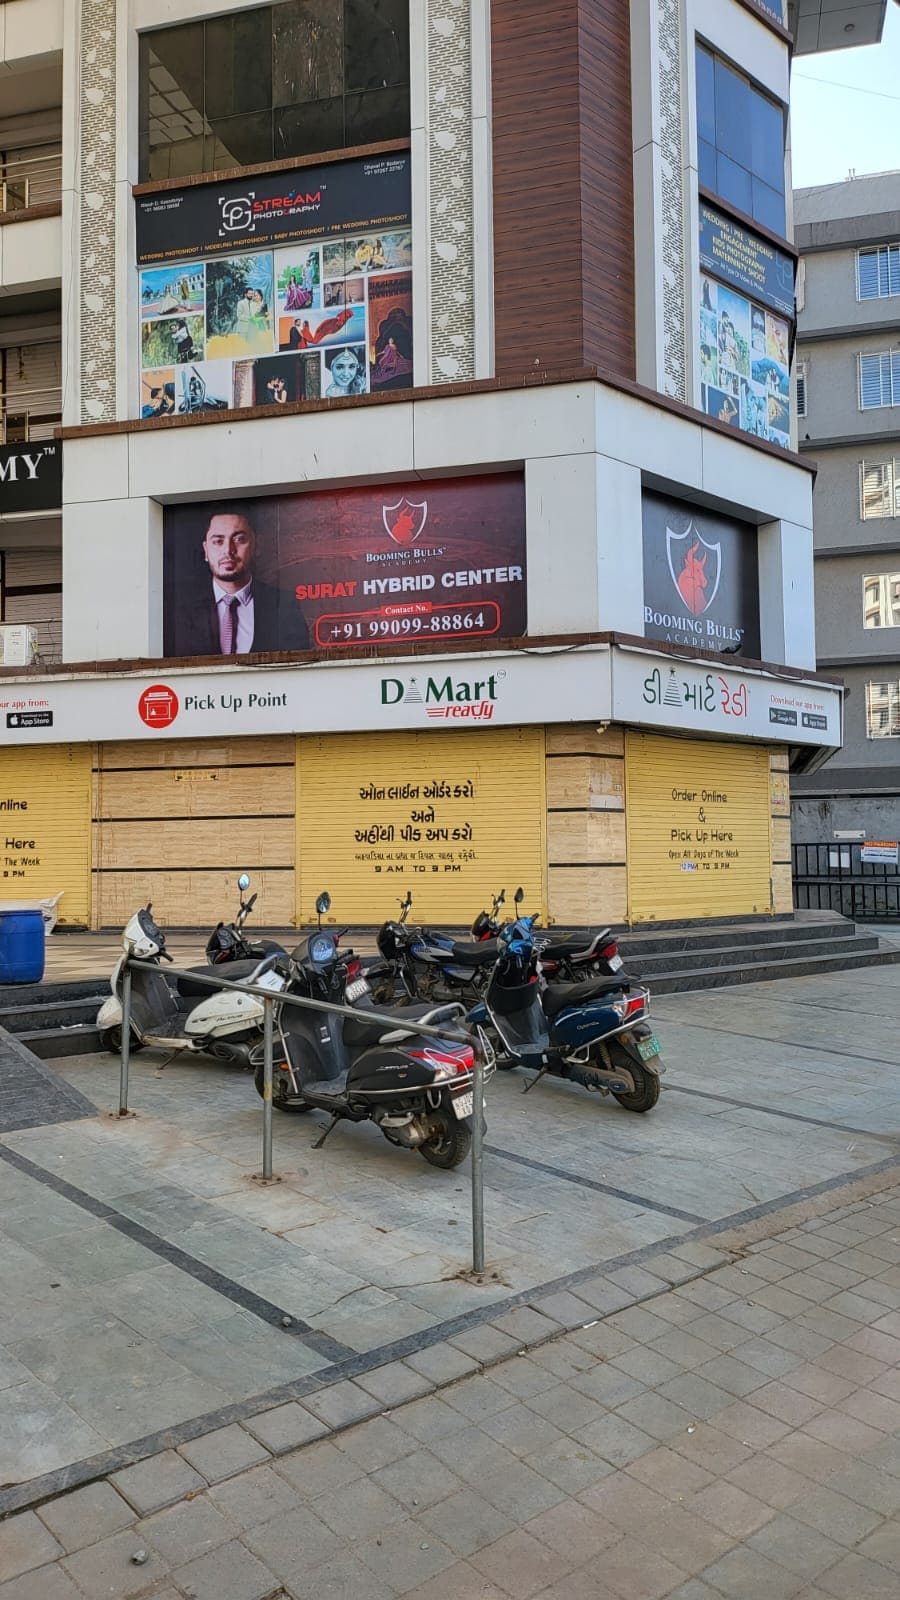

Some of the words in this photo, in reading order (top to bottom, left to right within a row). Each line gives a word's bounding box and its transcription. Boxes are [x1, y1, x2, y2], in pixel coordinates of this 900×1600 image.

[253, 191, 321, 212] STREAM
[253, 203, 321, 220] PHOTOGRAPHY
[366, 551, 410, 563] BOOMING
[413, 547, 443, 558] BULLS
[295, 581, 357, 600] SURAT
[363, 574, 436, 595] HYBRID
[441, 565, 523, 588] CENTER
[385, 605, 414, 615] Contact
[415, 604, 428, 613] No.
[330, 623, 362, 639] +91
[369, 612, 484, 636] 99099-88864
[644, 606, 702, 634] BOOMING
[706, 620, 741, 642] BULLS
[666, 633, 722, 649] ACADEMY
[185, 694, 215, 710] Pick
[221, 694, 242, 712] Up
[248, 692, 287, 708] Point
[718, 676, 747, 717] રેડી
[12, 701, 26, 709] app
[21, 718, 33, 726] App
[359, 783, 385, 800] ઓન
[388, 783, 419, 799] લાઈન
[423, 780, 451, 798] ઓર્ડર
[453, 780, 474, 798] કરો
[671, 788, 697, 801] Order
[701, 790, 728, 803] Online
[411, 806, 435, 823] અને
[698, 807, 706, 823] &
[354, 824, 394, 844] અહીંથી
[400, 824, 421, 841] પીક
[426, 828, 448, 840] અપ
[452, 822, 473, 840] કરો
[671, 829, 692, 841] Pick
[696, 829, 708, 844] Up
[711, 829, 733, 841] Here
[5, 837, 36, 849] Here
[4, 857, 17, 866] The
[21, 857, 40, 866] Week
[694, 849, 706, 859] Days
[444, 864, 462, 872] PM
